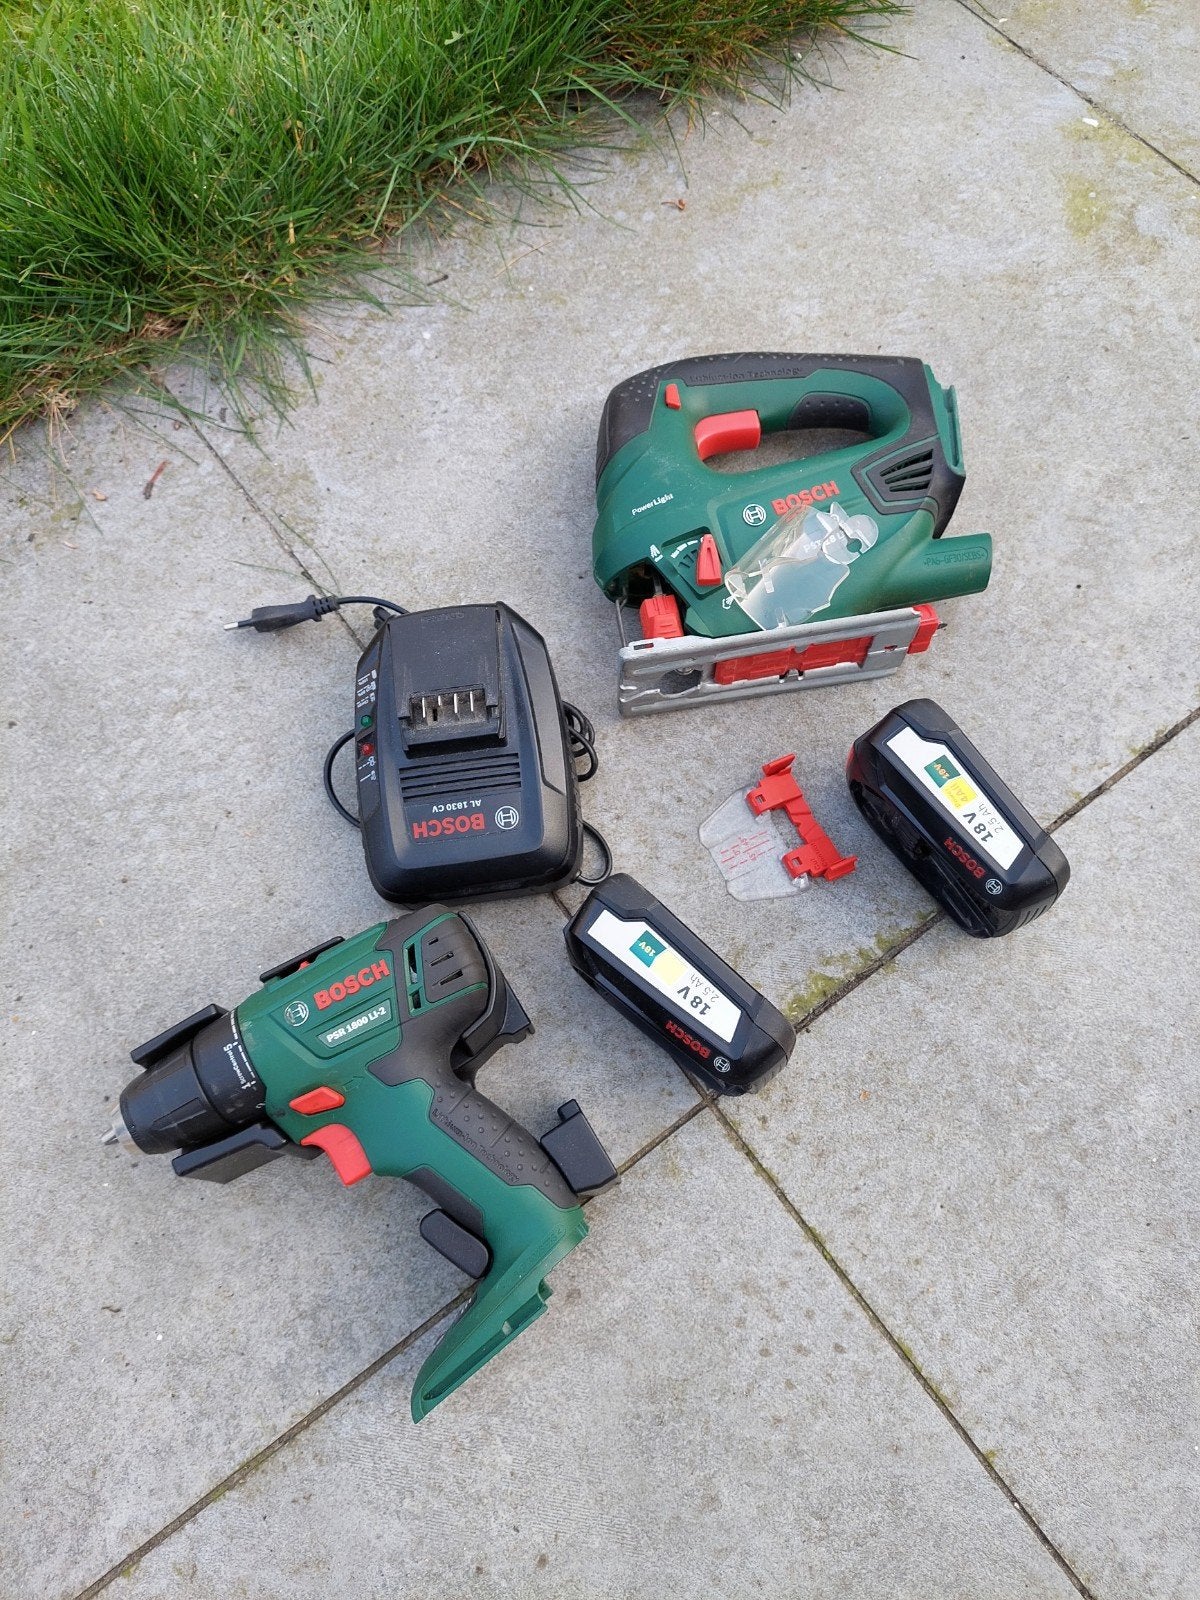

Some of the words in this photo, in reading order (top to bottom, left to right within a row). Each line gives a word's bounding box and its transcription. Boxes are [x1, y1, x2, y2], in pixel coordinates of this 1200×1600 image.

[747, 367, 801, 379] Technology
[631, 493, 674, 515] PowerLight
[772, 480, 840, 515] BOSCH
[933, 763, 950, 779] 18V
[432, 804, 445, 813] CV
[446, 800, 468, 811] 1830
[470, 799, 481, 808] AL
[978, 803, 991, 817] Ah
[412, 813, 486, 839] BOSCH
[963, 812, 977, 825] V
[989, 818, 1004, 834] 2,5
[973, 822, 994, 843] 18
[943, 837, 986, 878] BOSCH
[638, 941, 656, 957] 18V
[313, 959, 390, 1010] BOSCH
[690, 974, 703, 988] Ah
[677, 986, 691, 1000] V
[702, 986, 719, 1003] 2,5
[690, 995, 711, 1016] 18
[326, 1027, 347, 1043] PSR
[346, 1016, 369, 1033] 1800
[223, 1043, 233, 1052] 5
[665, 1020, 711, 1059] BOSCH
[478, 1145, 520, 1183] Technology
